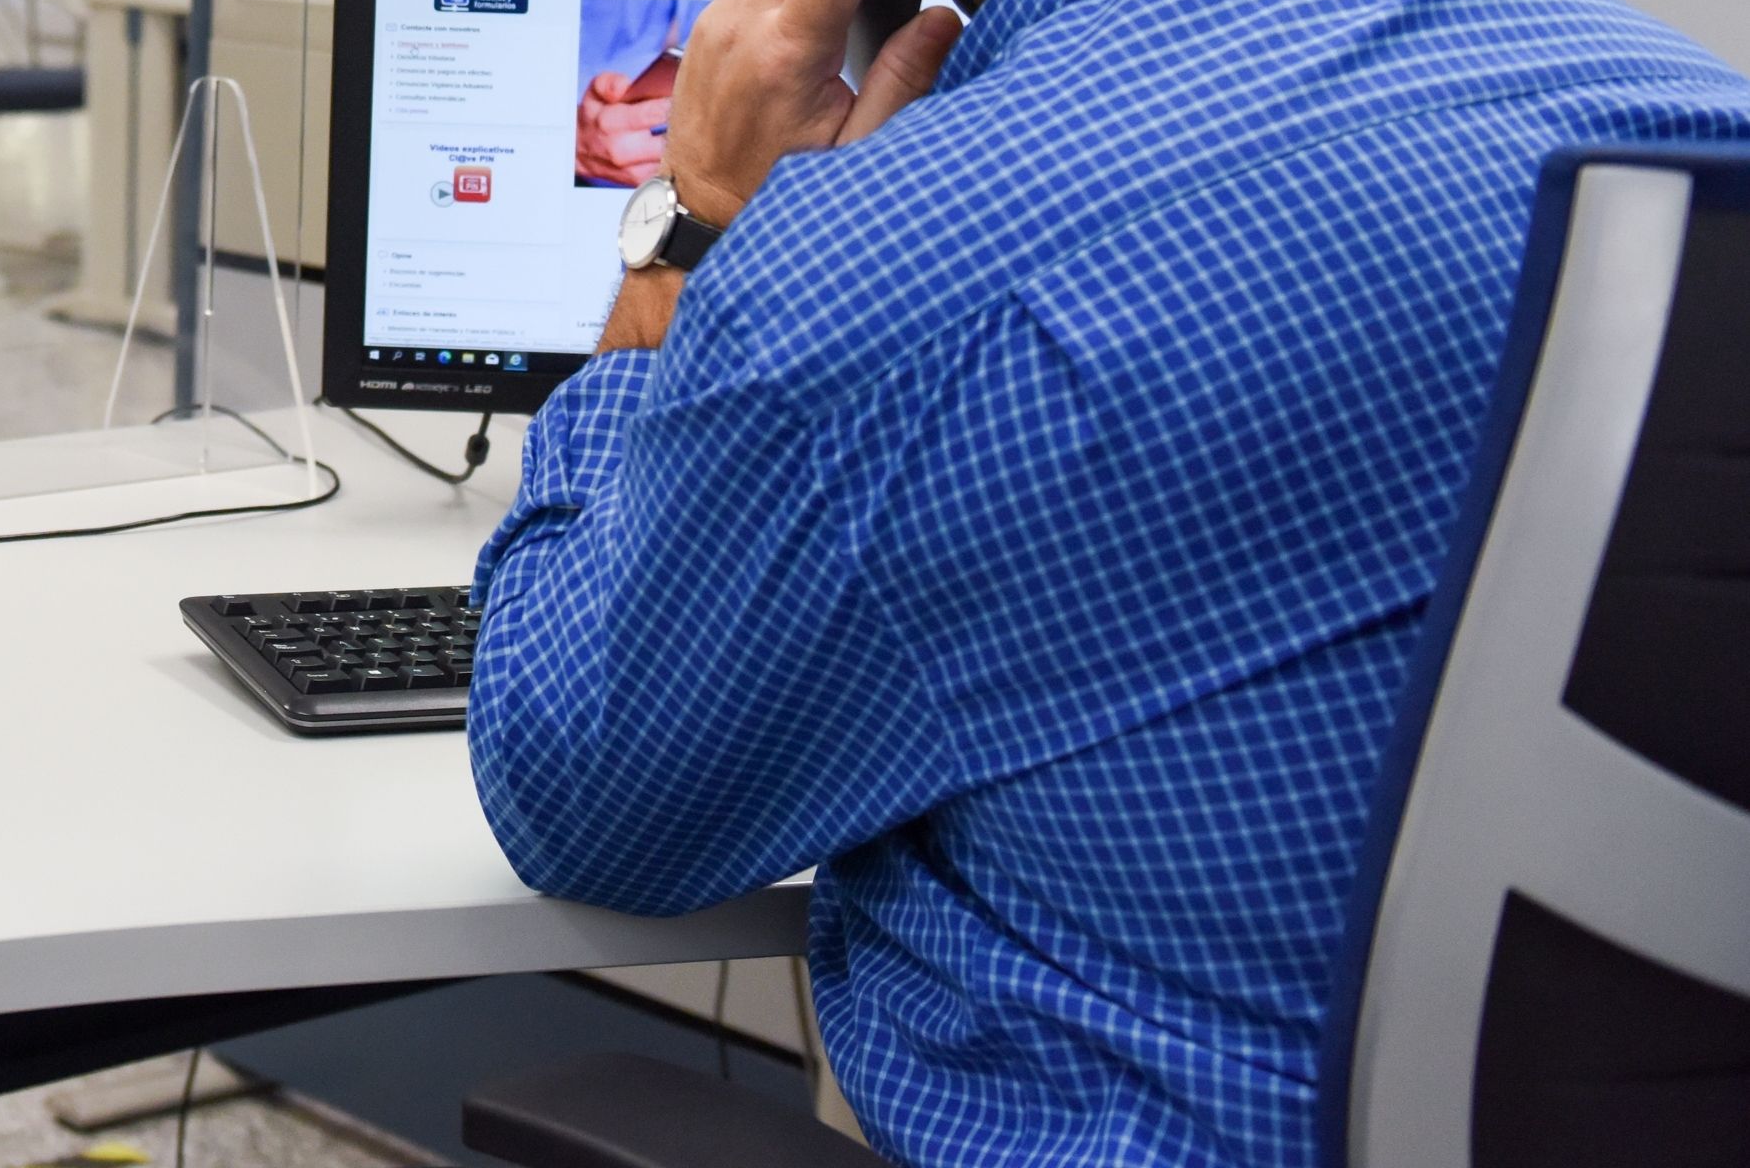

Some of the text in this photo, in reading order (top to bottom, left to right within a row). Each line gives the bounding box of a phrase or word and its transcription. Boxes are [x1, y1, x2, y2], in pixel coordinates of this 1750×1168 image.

[474, 1, 517, 10] formularios
[462, 145, 515, 154] explicativos
[479, 155, 495, 163] PIN
[360, 380, 397, 390] HDMI
